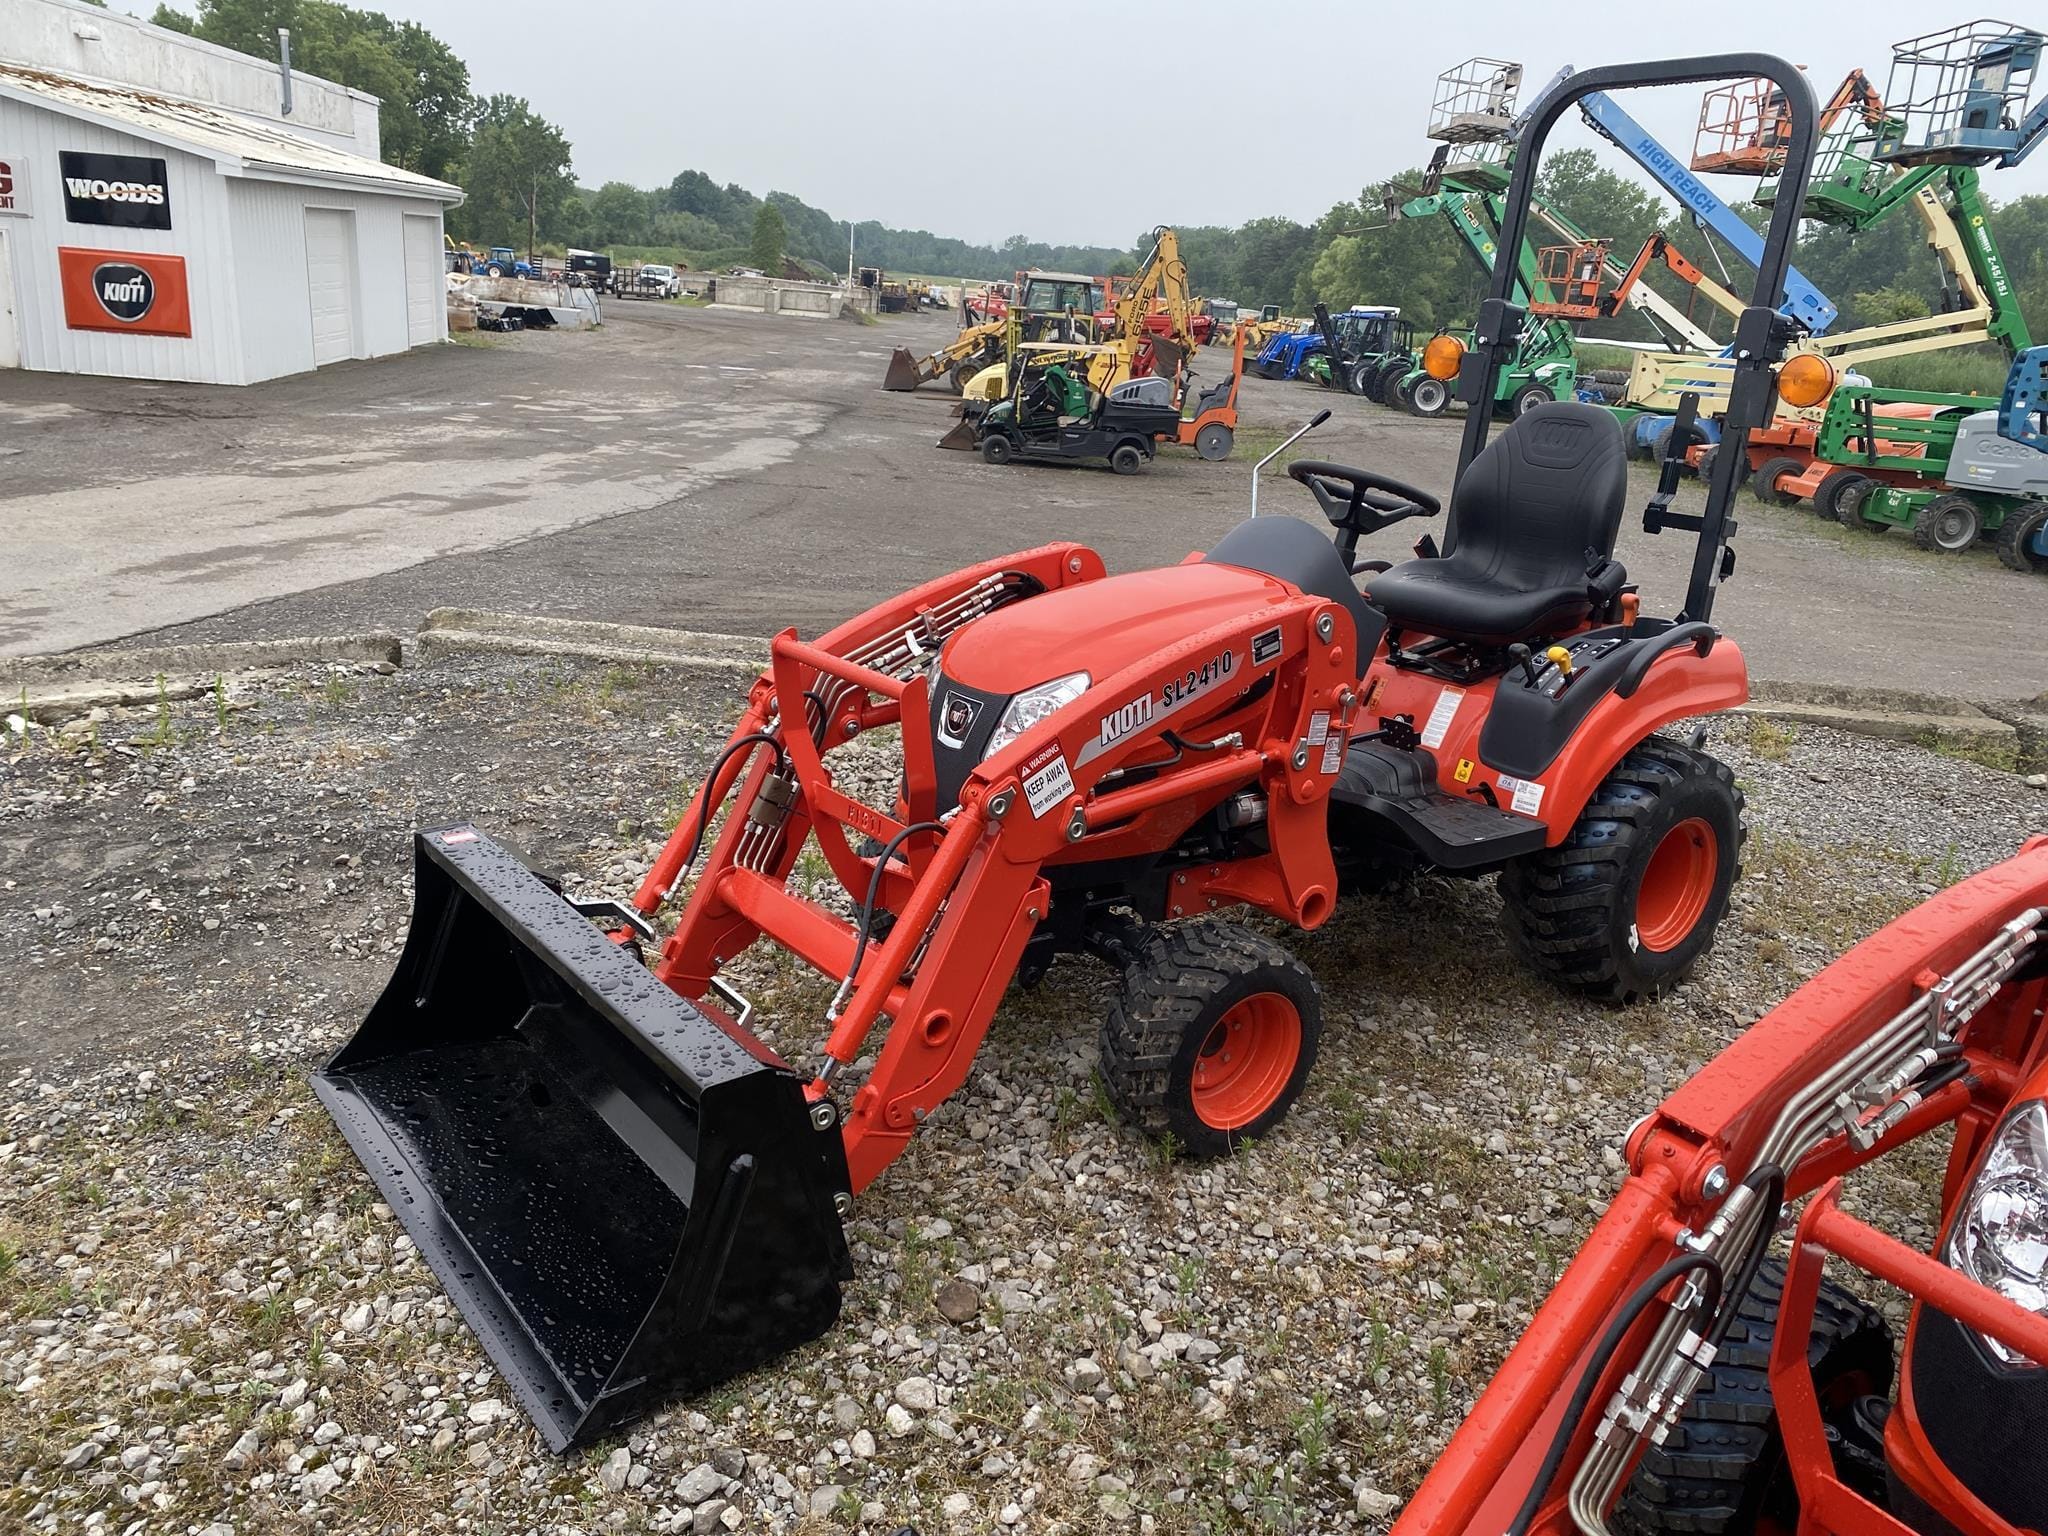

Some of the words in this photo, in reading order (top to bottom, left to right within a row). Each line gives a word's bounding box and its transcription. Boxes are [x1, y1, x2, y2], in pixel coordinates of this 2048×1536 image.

[65, 177, 164, 205] WOODS
[1637, 139, 1675, 174] HIGH
[1670, 171, 1717, 214] REACH
[1461, 205, 1480, 229] JCB
[104, 279, 146, 304] KIOTI
[1128, 300, 1139, 324] FORD
[1132, 287, 1154, 337] 655E
[1100, 690, 1154, 747] KIOTI
[1162, 649, 1234, 708] SL2410
[1028, 743, 1060, 770] WARNING
[1025, 776, 1045, 799] KEEP
[1045, 760, 1067, 785] AWAY
[1032, 799, 1045, 812] from
[1044, 785, 1063, 805] working
[1062, 779, 1072, 792] area
